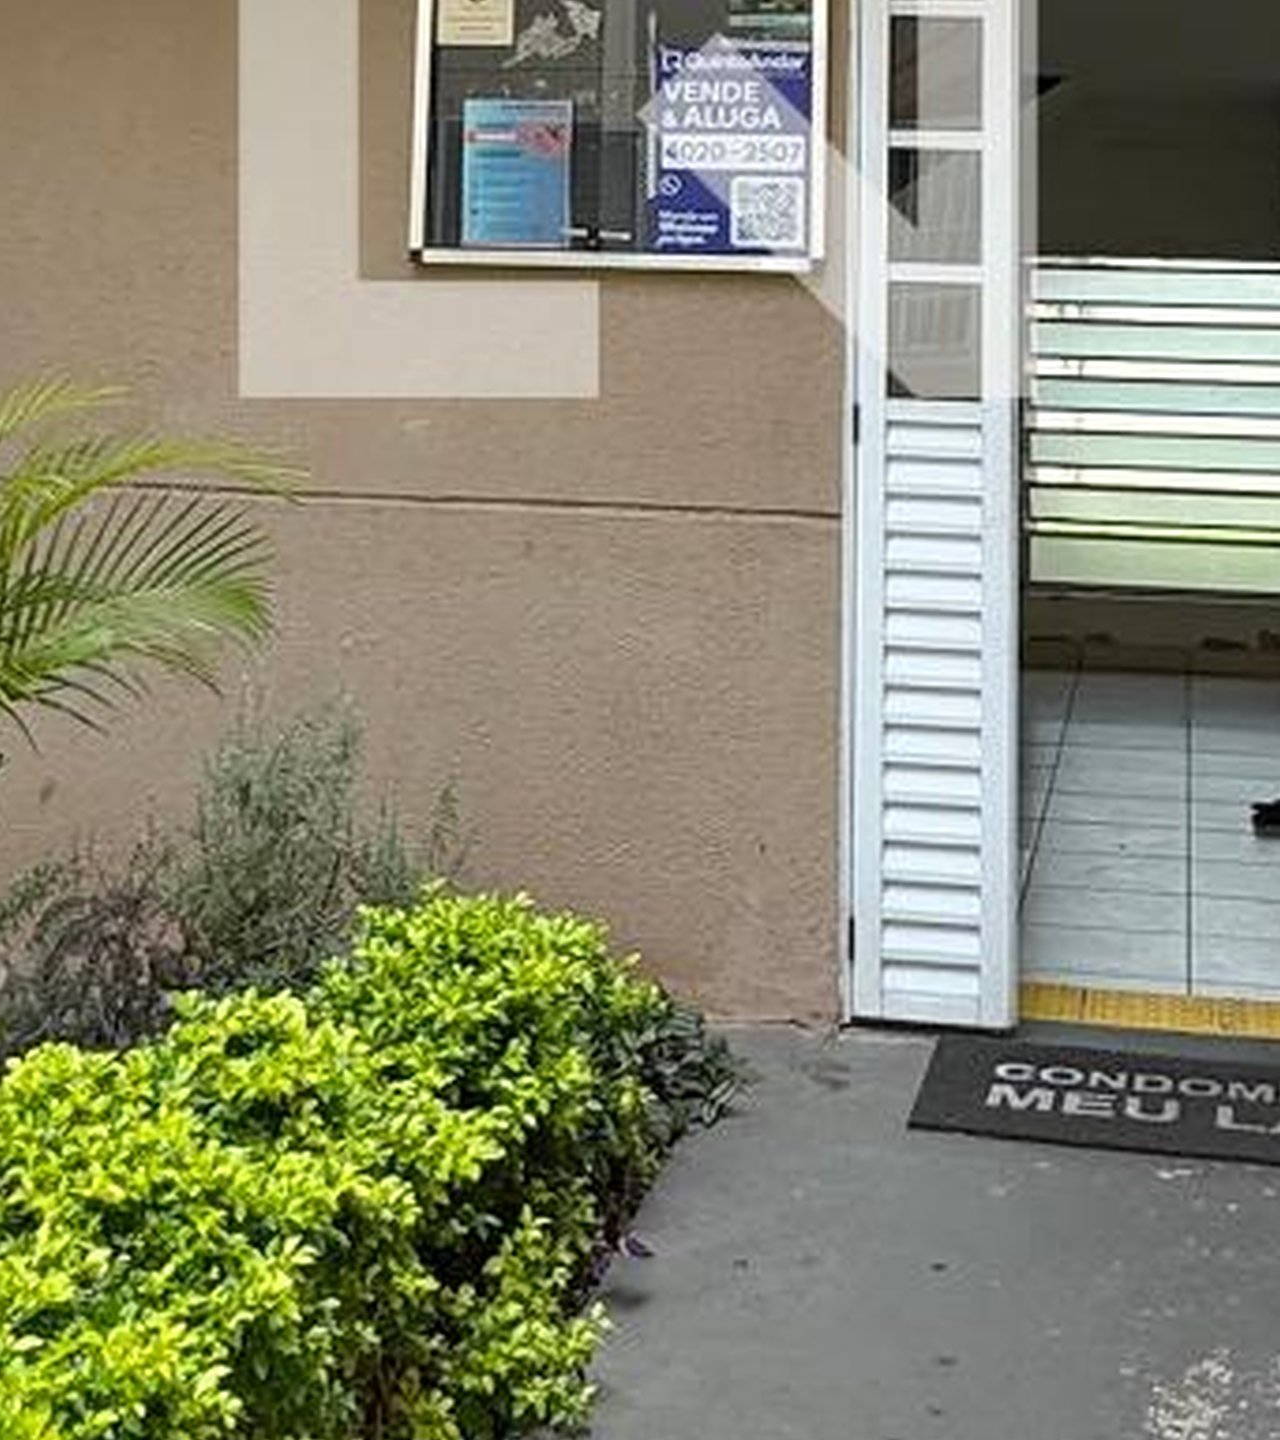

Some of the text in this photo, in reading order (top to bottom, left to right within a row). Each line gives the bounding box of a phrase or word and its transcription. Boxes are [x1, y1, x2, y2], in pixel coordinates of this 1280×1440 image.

[663, 81, 761, 104] VENDE
[682, 106, 782, 130] ALUGA
[985, 1084, 1180, 1122] MEU
